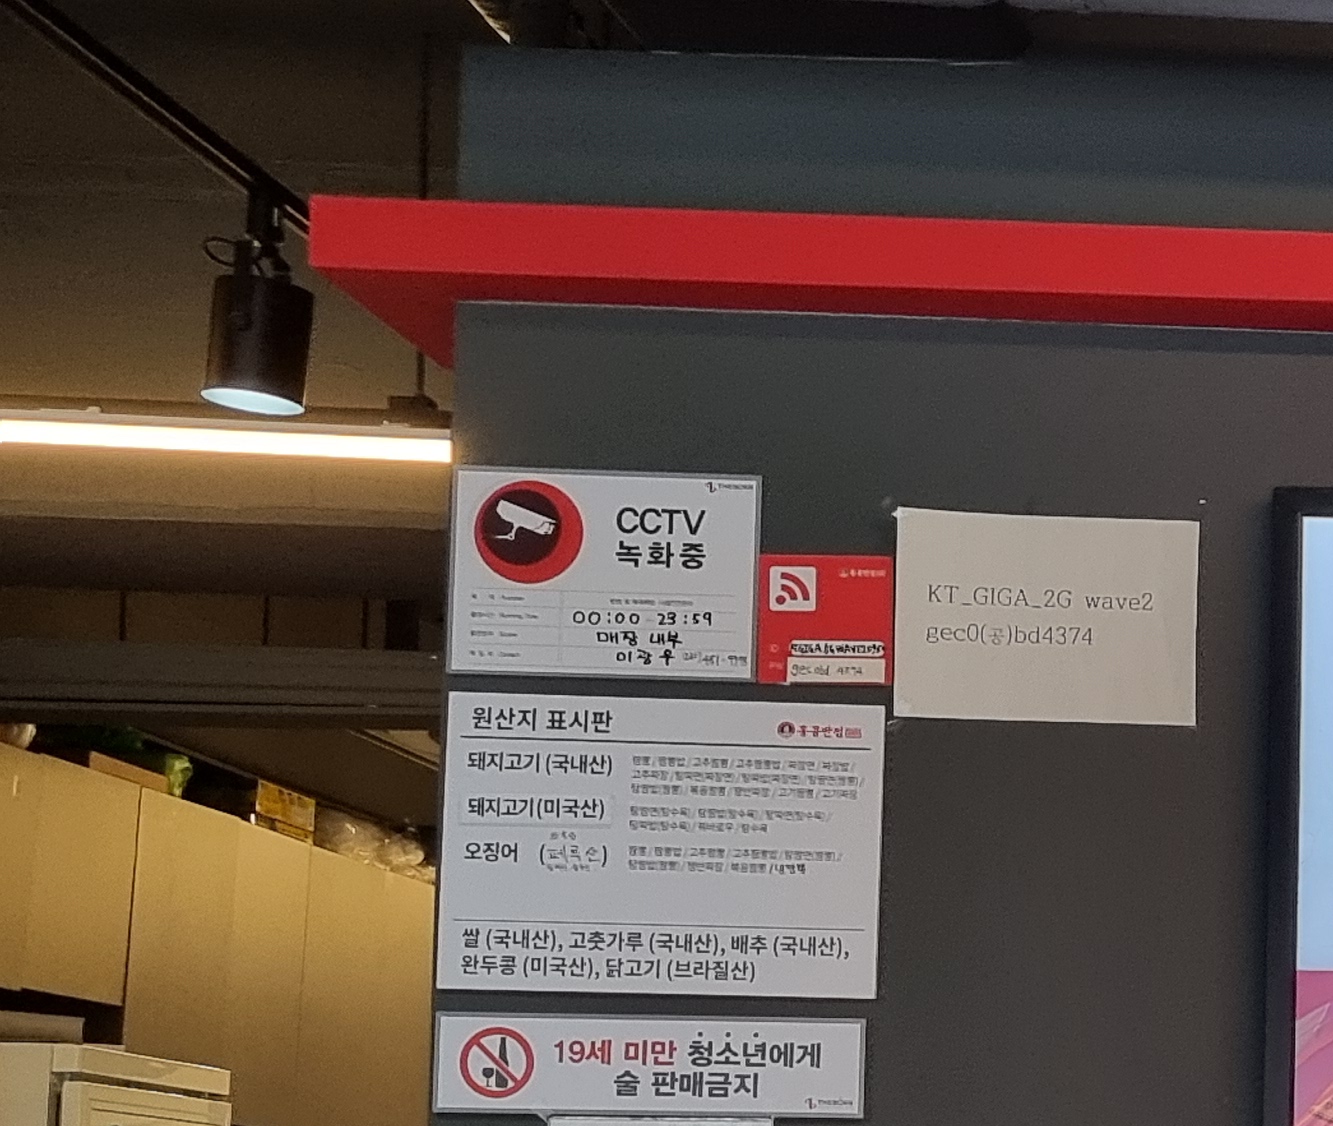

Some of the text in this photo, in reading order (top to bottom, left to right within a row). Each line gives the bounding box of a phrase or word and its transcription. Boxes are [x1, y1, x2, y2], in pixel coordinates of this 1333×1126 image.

[616, 507, 706, 535] CCTV
[615, 541, 706, 570] 녹화중
[928, 584, 1154, 611] KT_GIGA_2G wave2
[597, 631, 683, 648] 매장 내부
[472, 706, 613, 733] 원산지 표시판
[467, 752, 540, 773] 돼지고기
[545, 754, 613, 777] (국내산)
[464, 842, 518, 863] 오징어
[462, 928, 849, 960] 쌀 (국내산), 고춧가루 (국내산), 배추 (국내산),
[461, 955, 756, 982] 완두콩 (미국산), 닭고기 (브라질산)
[554, 1038, 822, 1068] 19세 미만 청소년에게
[614, 1070, 759, 1098] 술 판매금지
